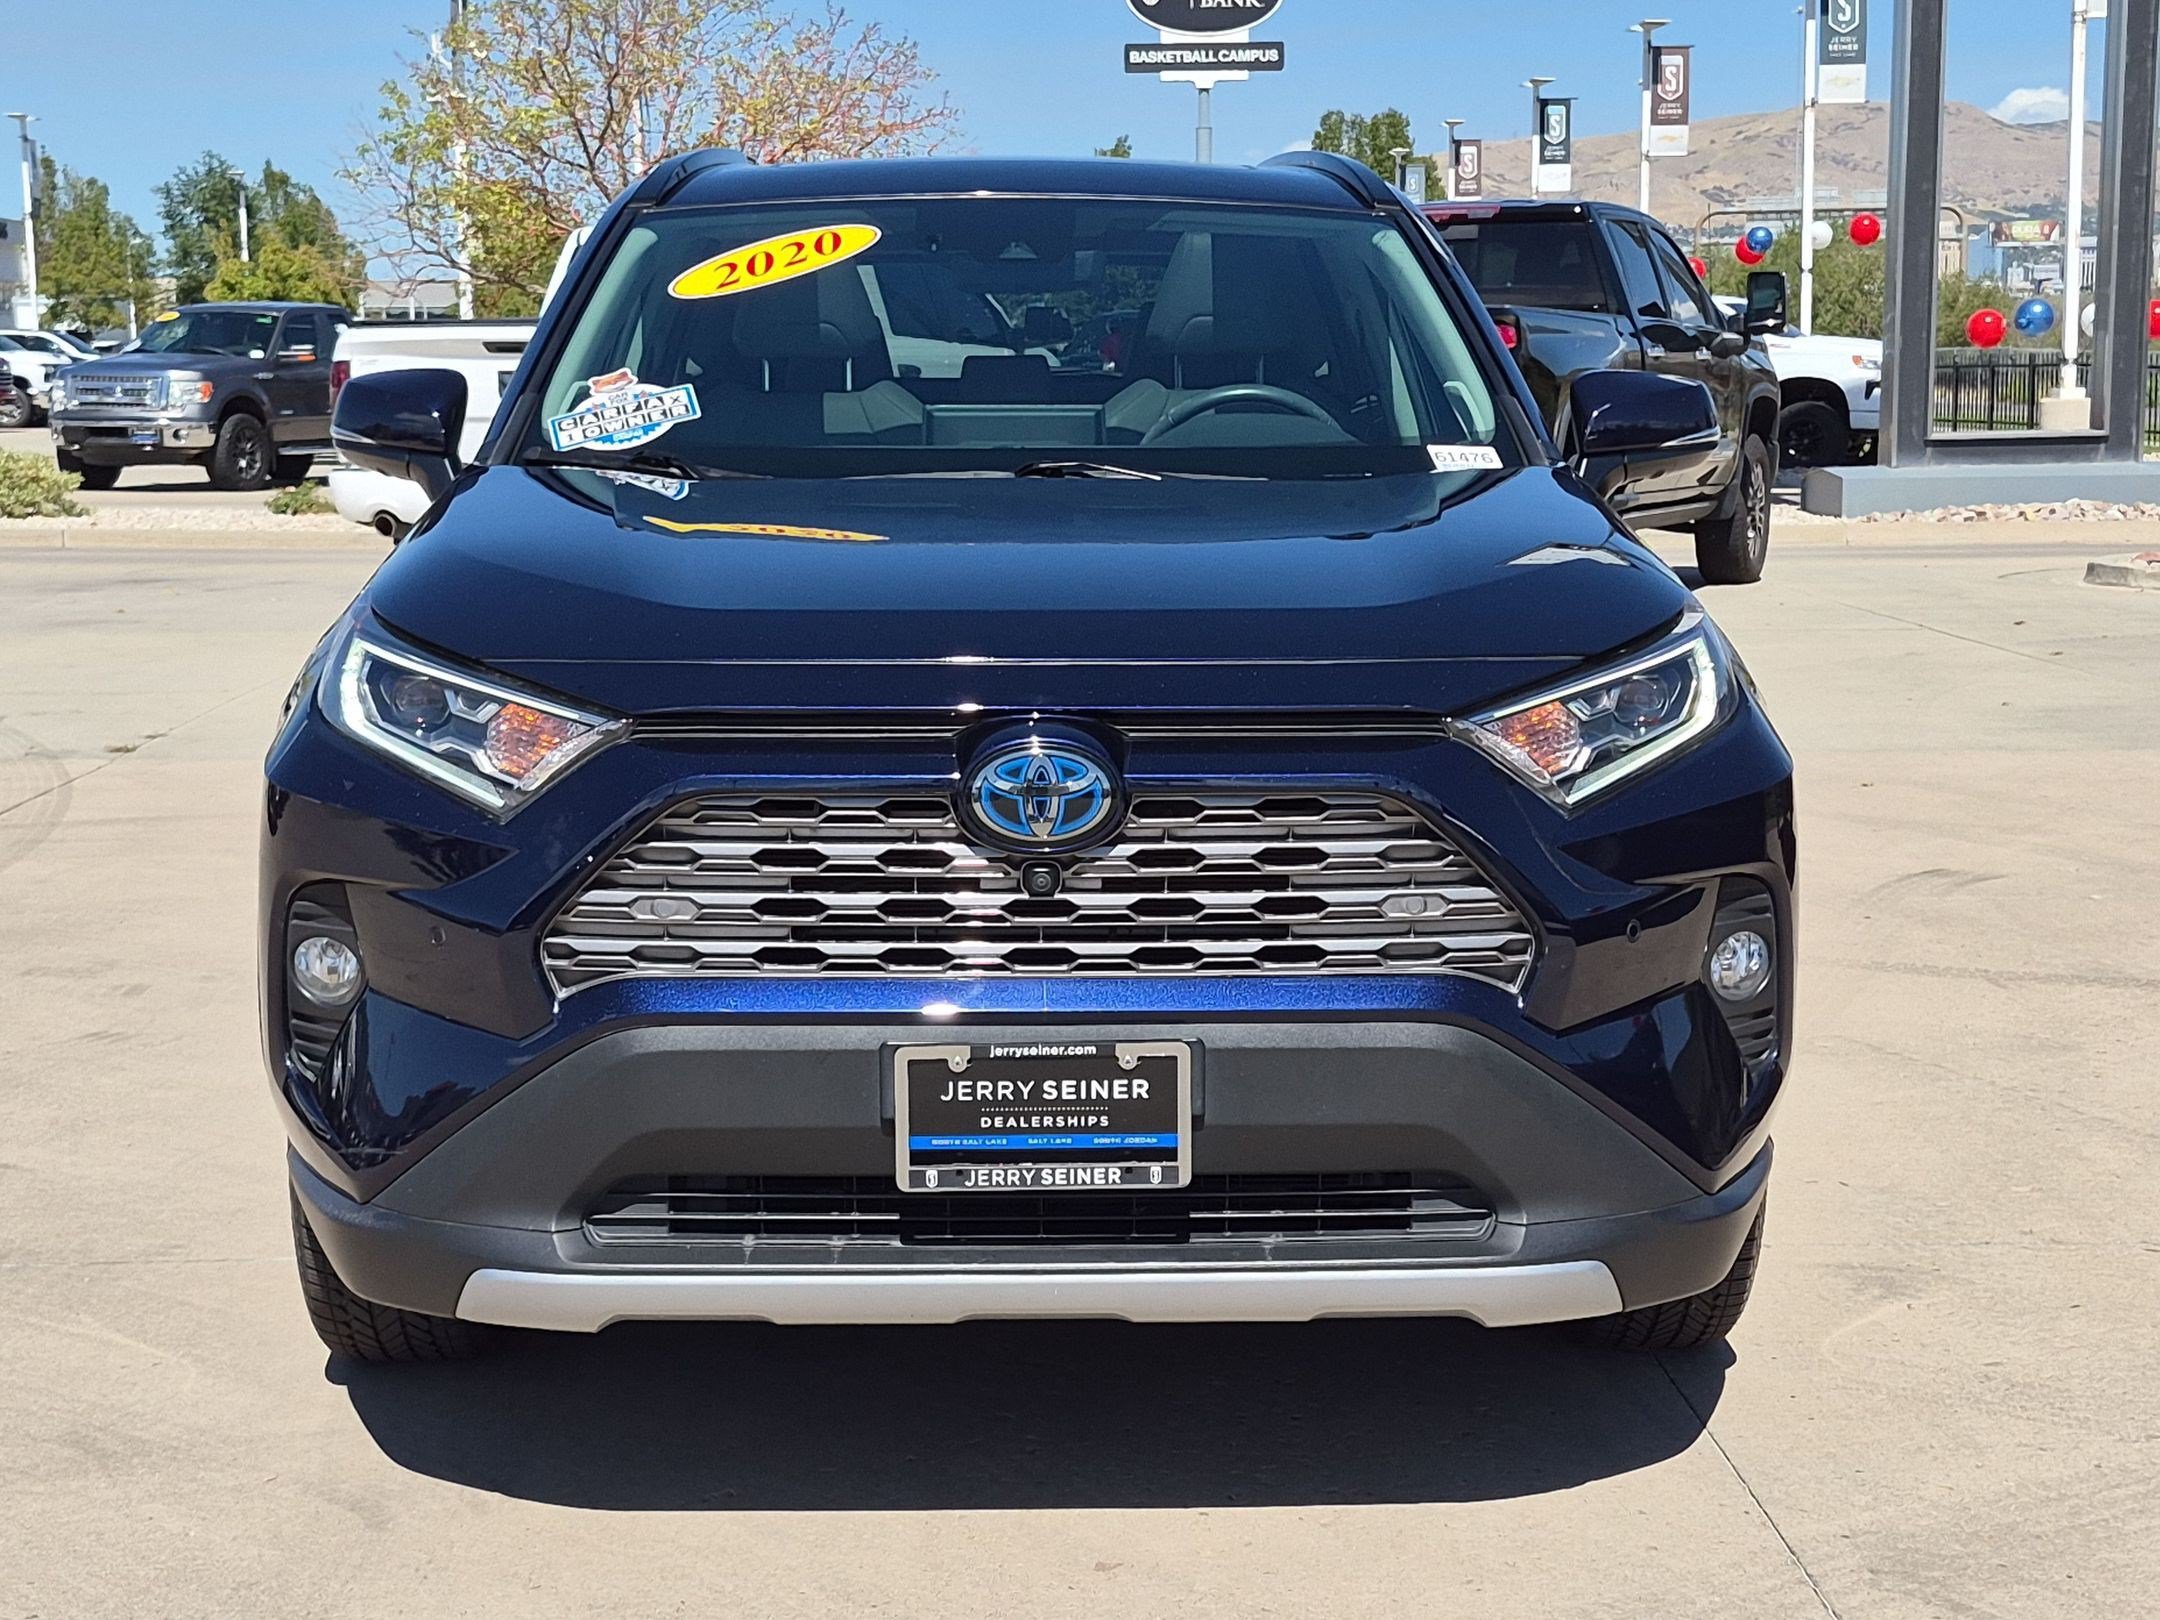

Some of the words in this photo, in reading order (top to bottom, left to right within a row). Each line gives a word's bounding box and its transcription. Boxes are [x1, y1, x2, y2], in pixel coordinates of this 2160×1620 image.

[1129, 50, 1217, 64] BASKETBALL
[1218, 49, 1279, 62] CAMPUS
[713, 231, 842, 289] 2020
[559, 395, 682, 431] CARFAX
[583, 404, 691, 439] OWNER
[989, 1042, 1097, 1058] jerryseiner.com
[940, 1080, 1035, 1102] JERRY
[1042, 1079, 1150, 1100] SEINER
[980, 1115, 1110, 1128] DEALERSHIPS
[964, 1169, 1035, 1187] JERRY
[1040, 1167, 1122, 1185] SEINER
